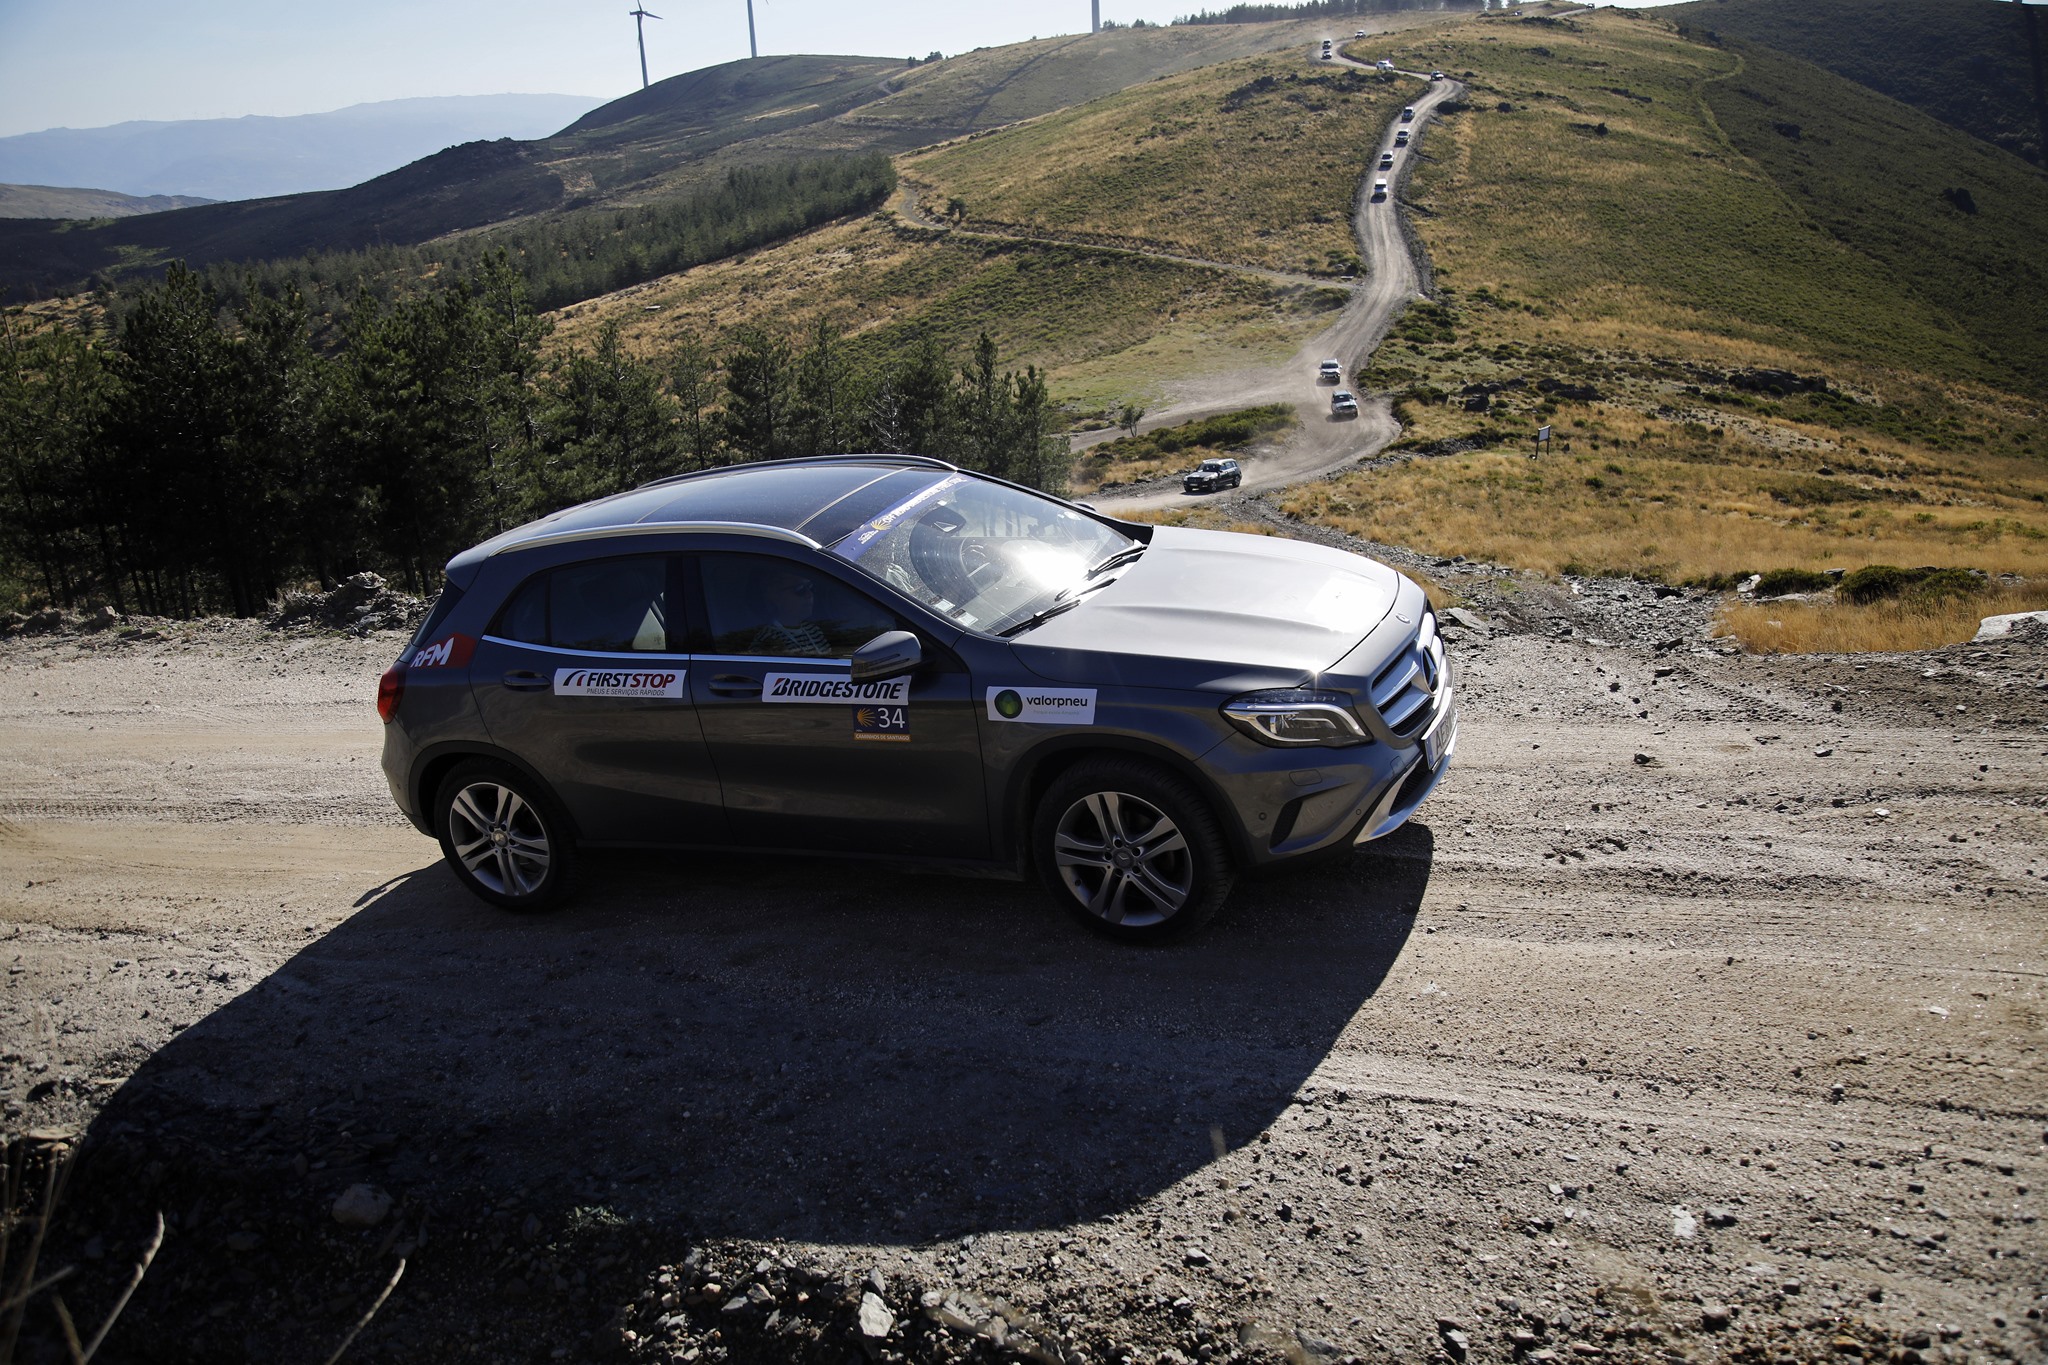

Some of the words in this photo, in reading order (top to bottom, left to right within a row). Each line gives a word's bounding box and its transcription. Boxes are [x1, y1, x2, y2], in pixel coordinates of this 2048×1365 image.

[410, 637, 454, 668] RFM
[611, 689, 639, 697] SERVIÇOS
[771, 678, 904, 699] BRIDGESTONE
[1026, 695, 1088, 708] valorpneu
[877, 707, 905, 728] 34
